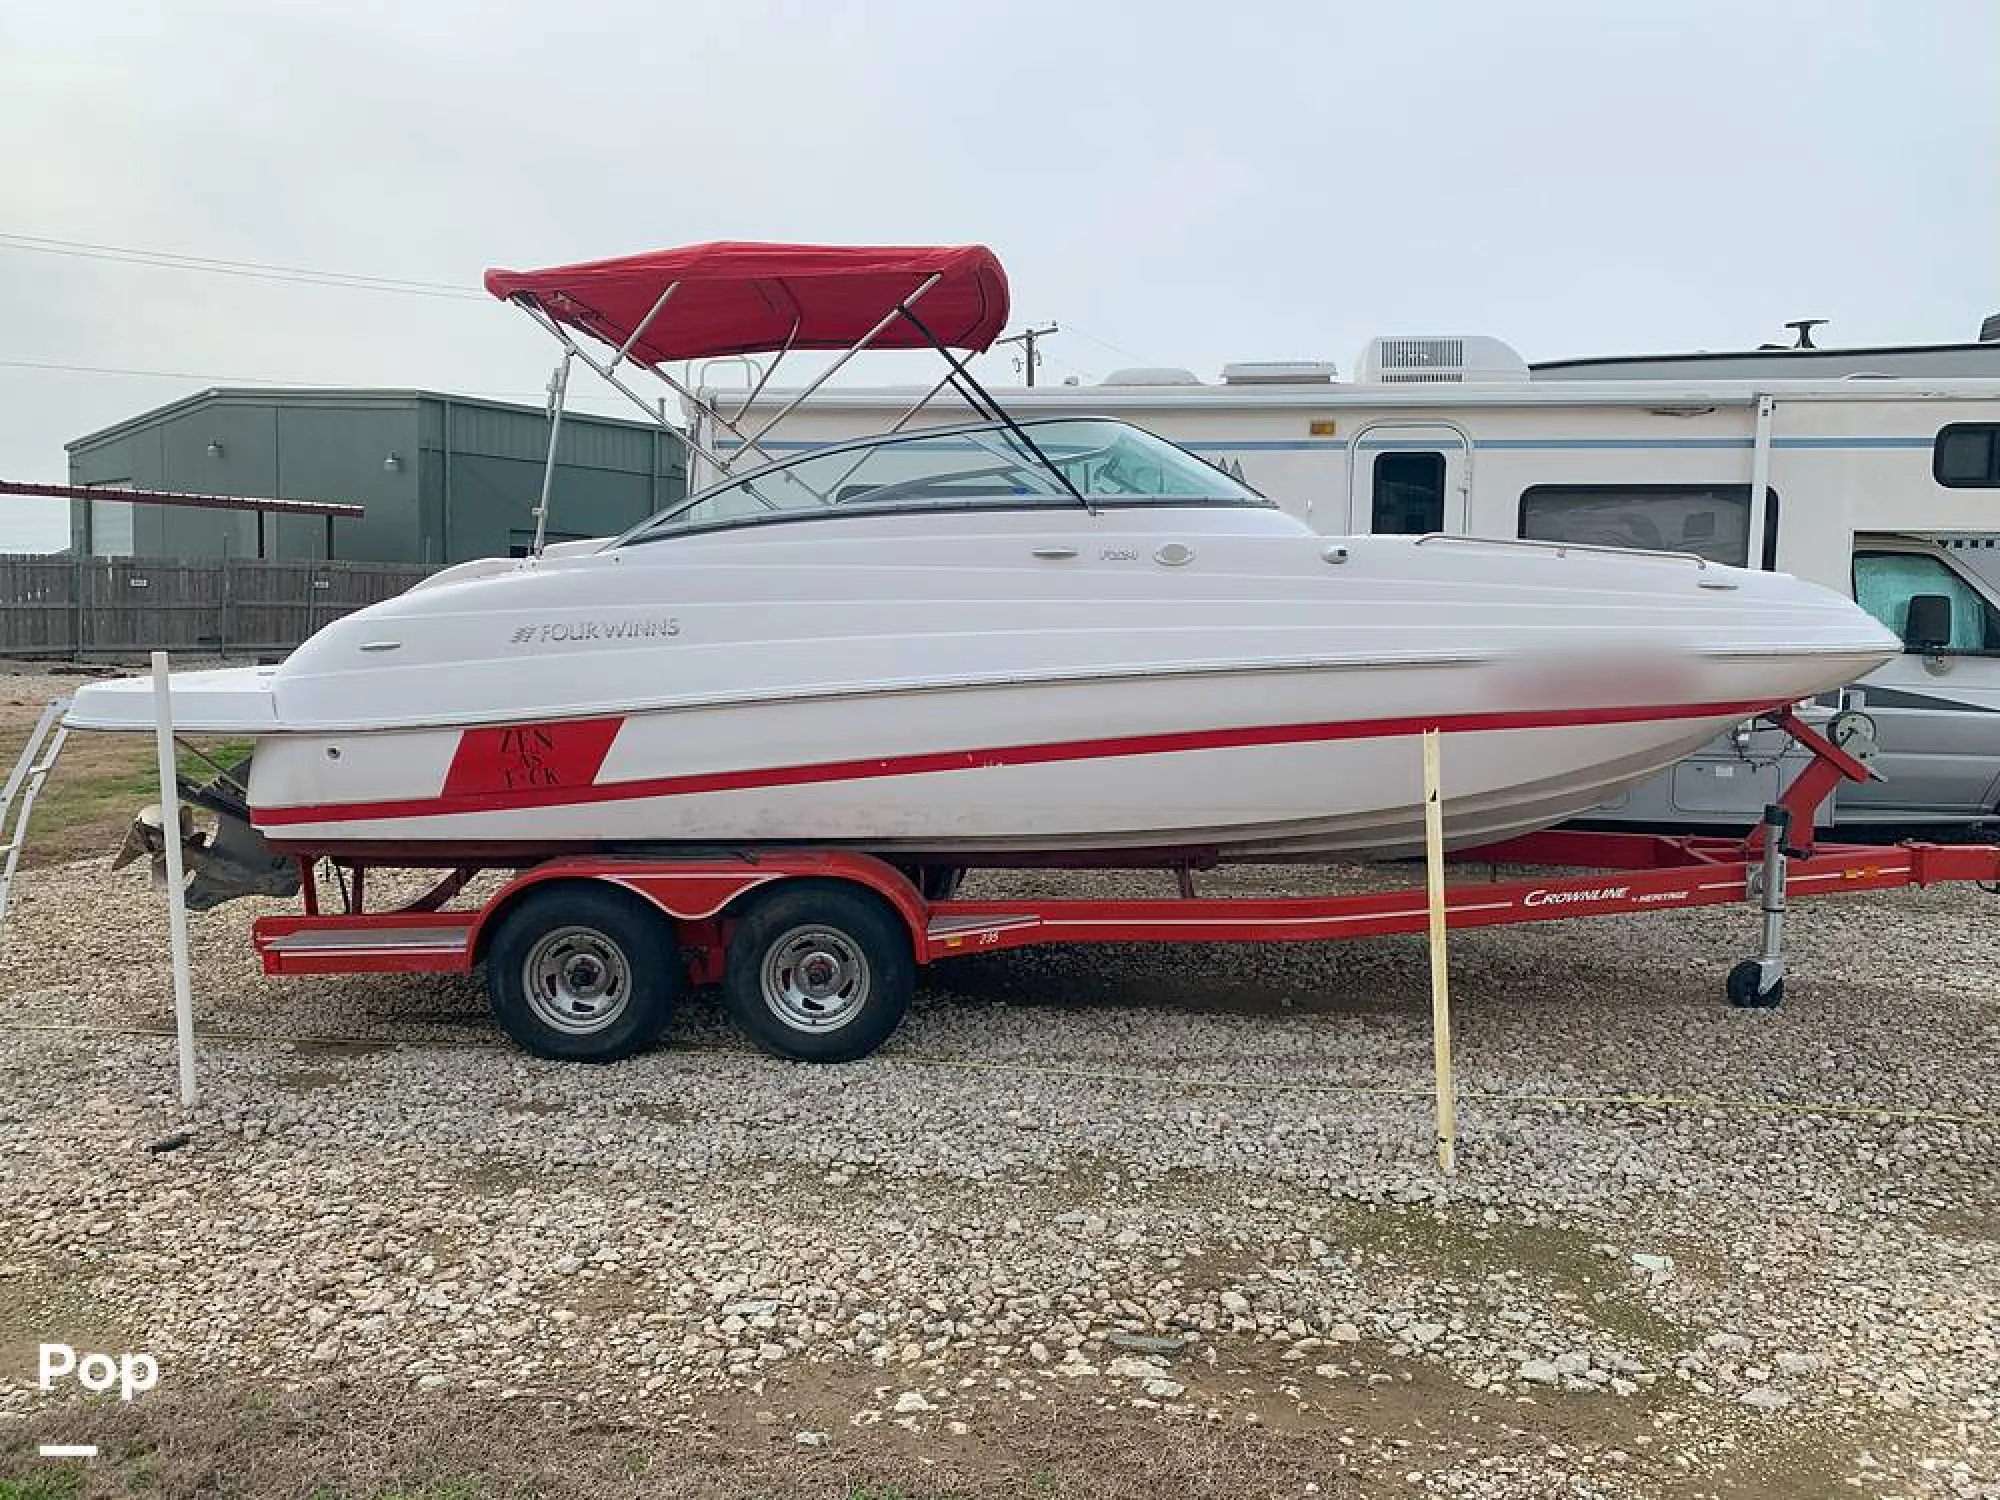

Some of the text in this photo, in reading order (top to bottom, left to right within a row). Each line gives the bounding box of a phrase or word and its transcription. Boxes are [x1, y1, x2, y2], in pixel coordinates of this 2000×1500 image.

[540, 617, 681, 642] FOUR WINNS
[500, 728, 553, 753] ZEN
[1523, 886, 1630, 907] CROWNLINE
